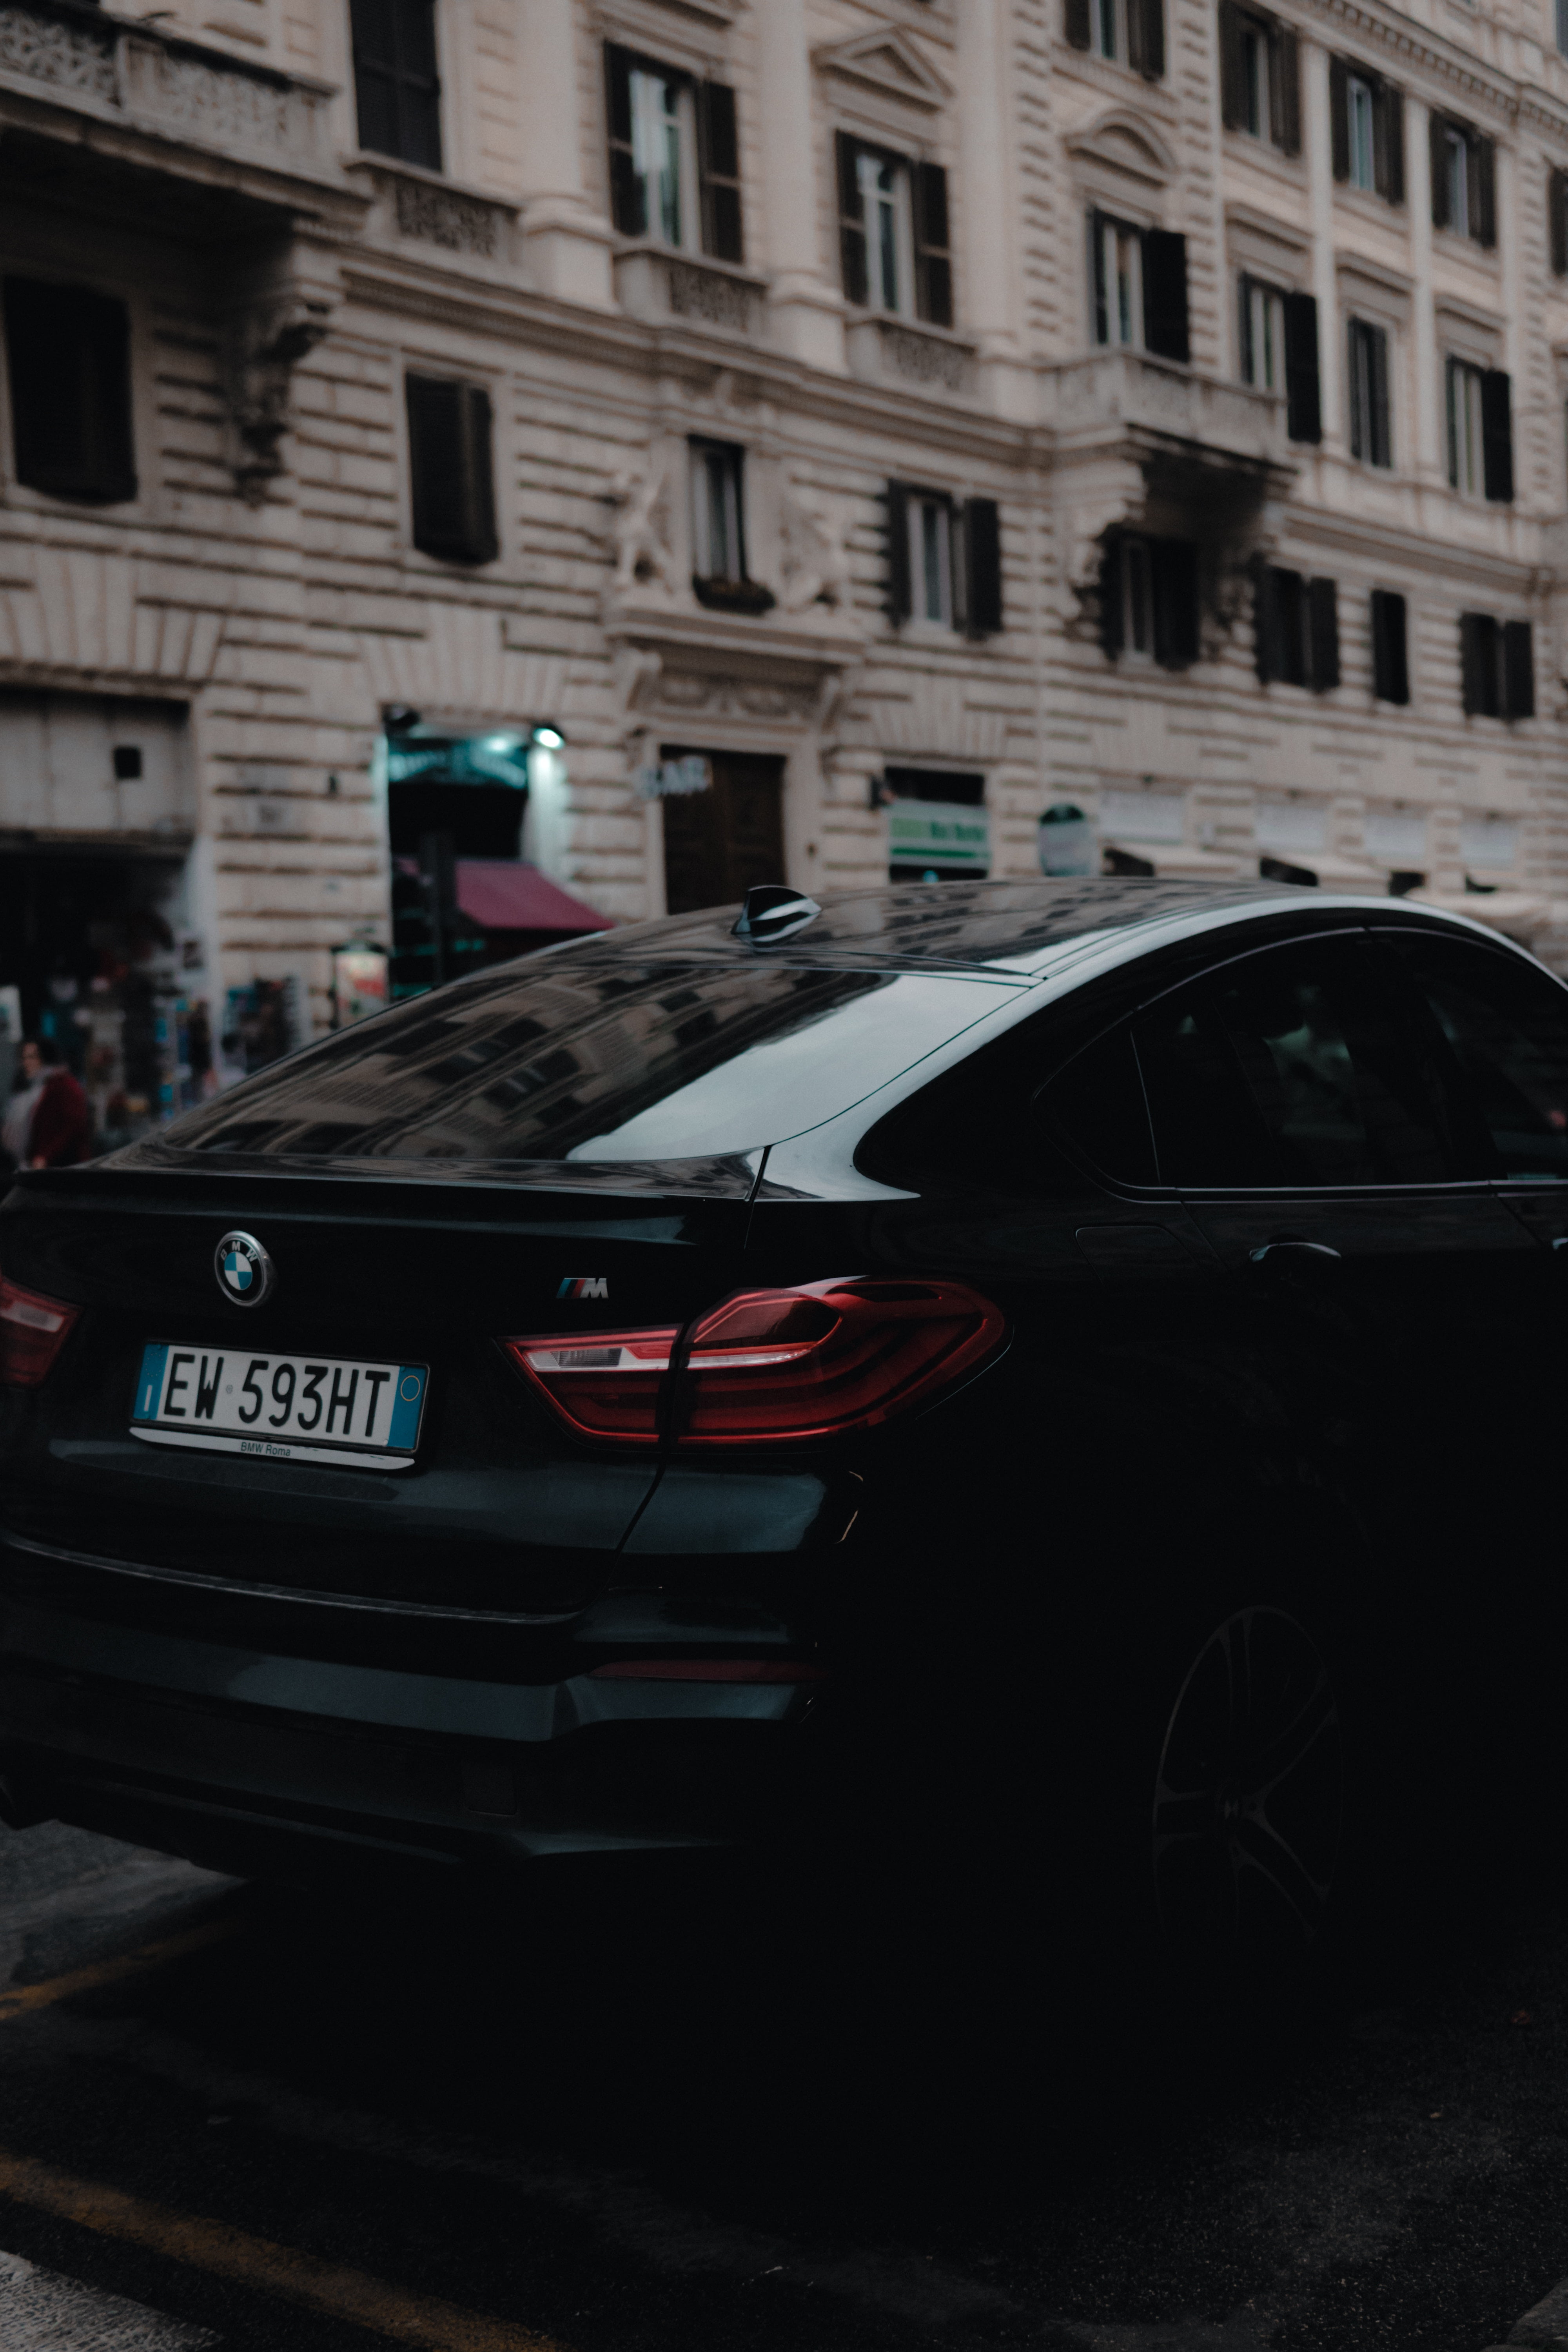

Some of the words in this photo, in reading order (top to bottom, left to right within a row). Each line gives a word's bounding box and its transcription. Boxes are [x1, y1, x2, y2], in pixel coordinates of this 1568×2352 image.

[220, 1241, 258, 1262] BMW
[164, 1353, 224, 1419] EW
[239, 1360, 391, 1437] 593HT
[241, 1441, 263, 1454] BMW
[265, 1444, 291, 1456] Roma
